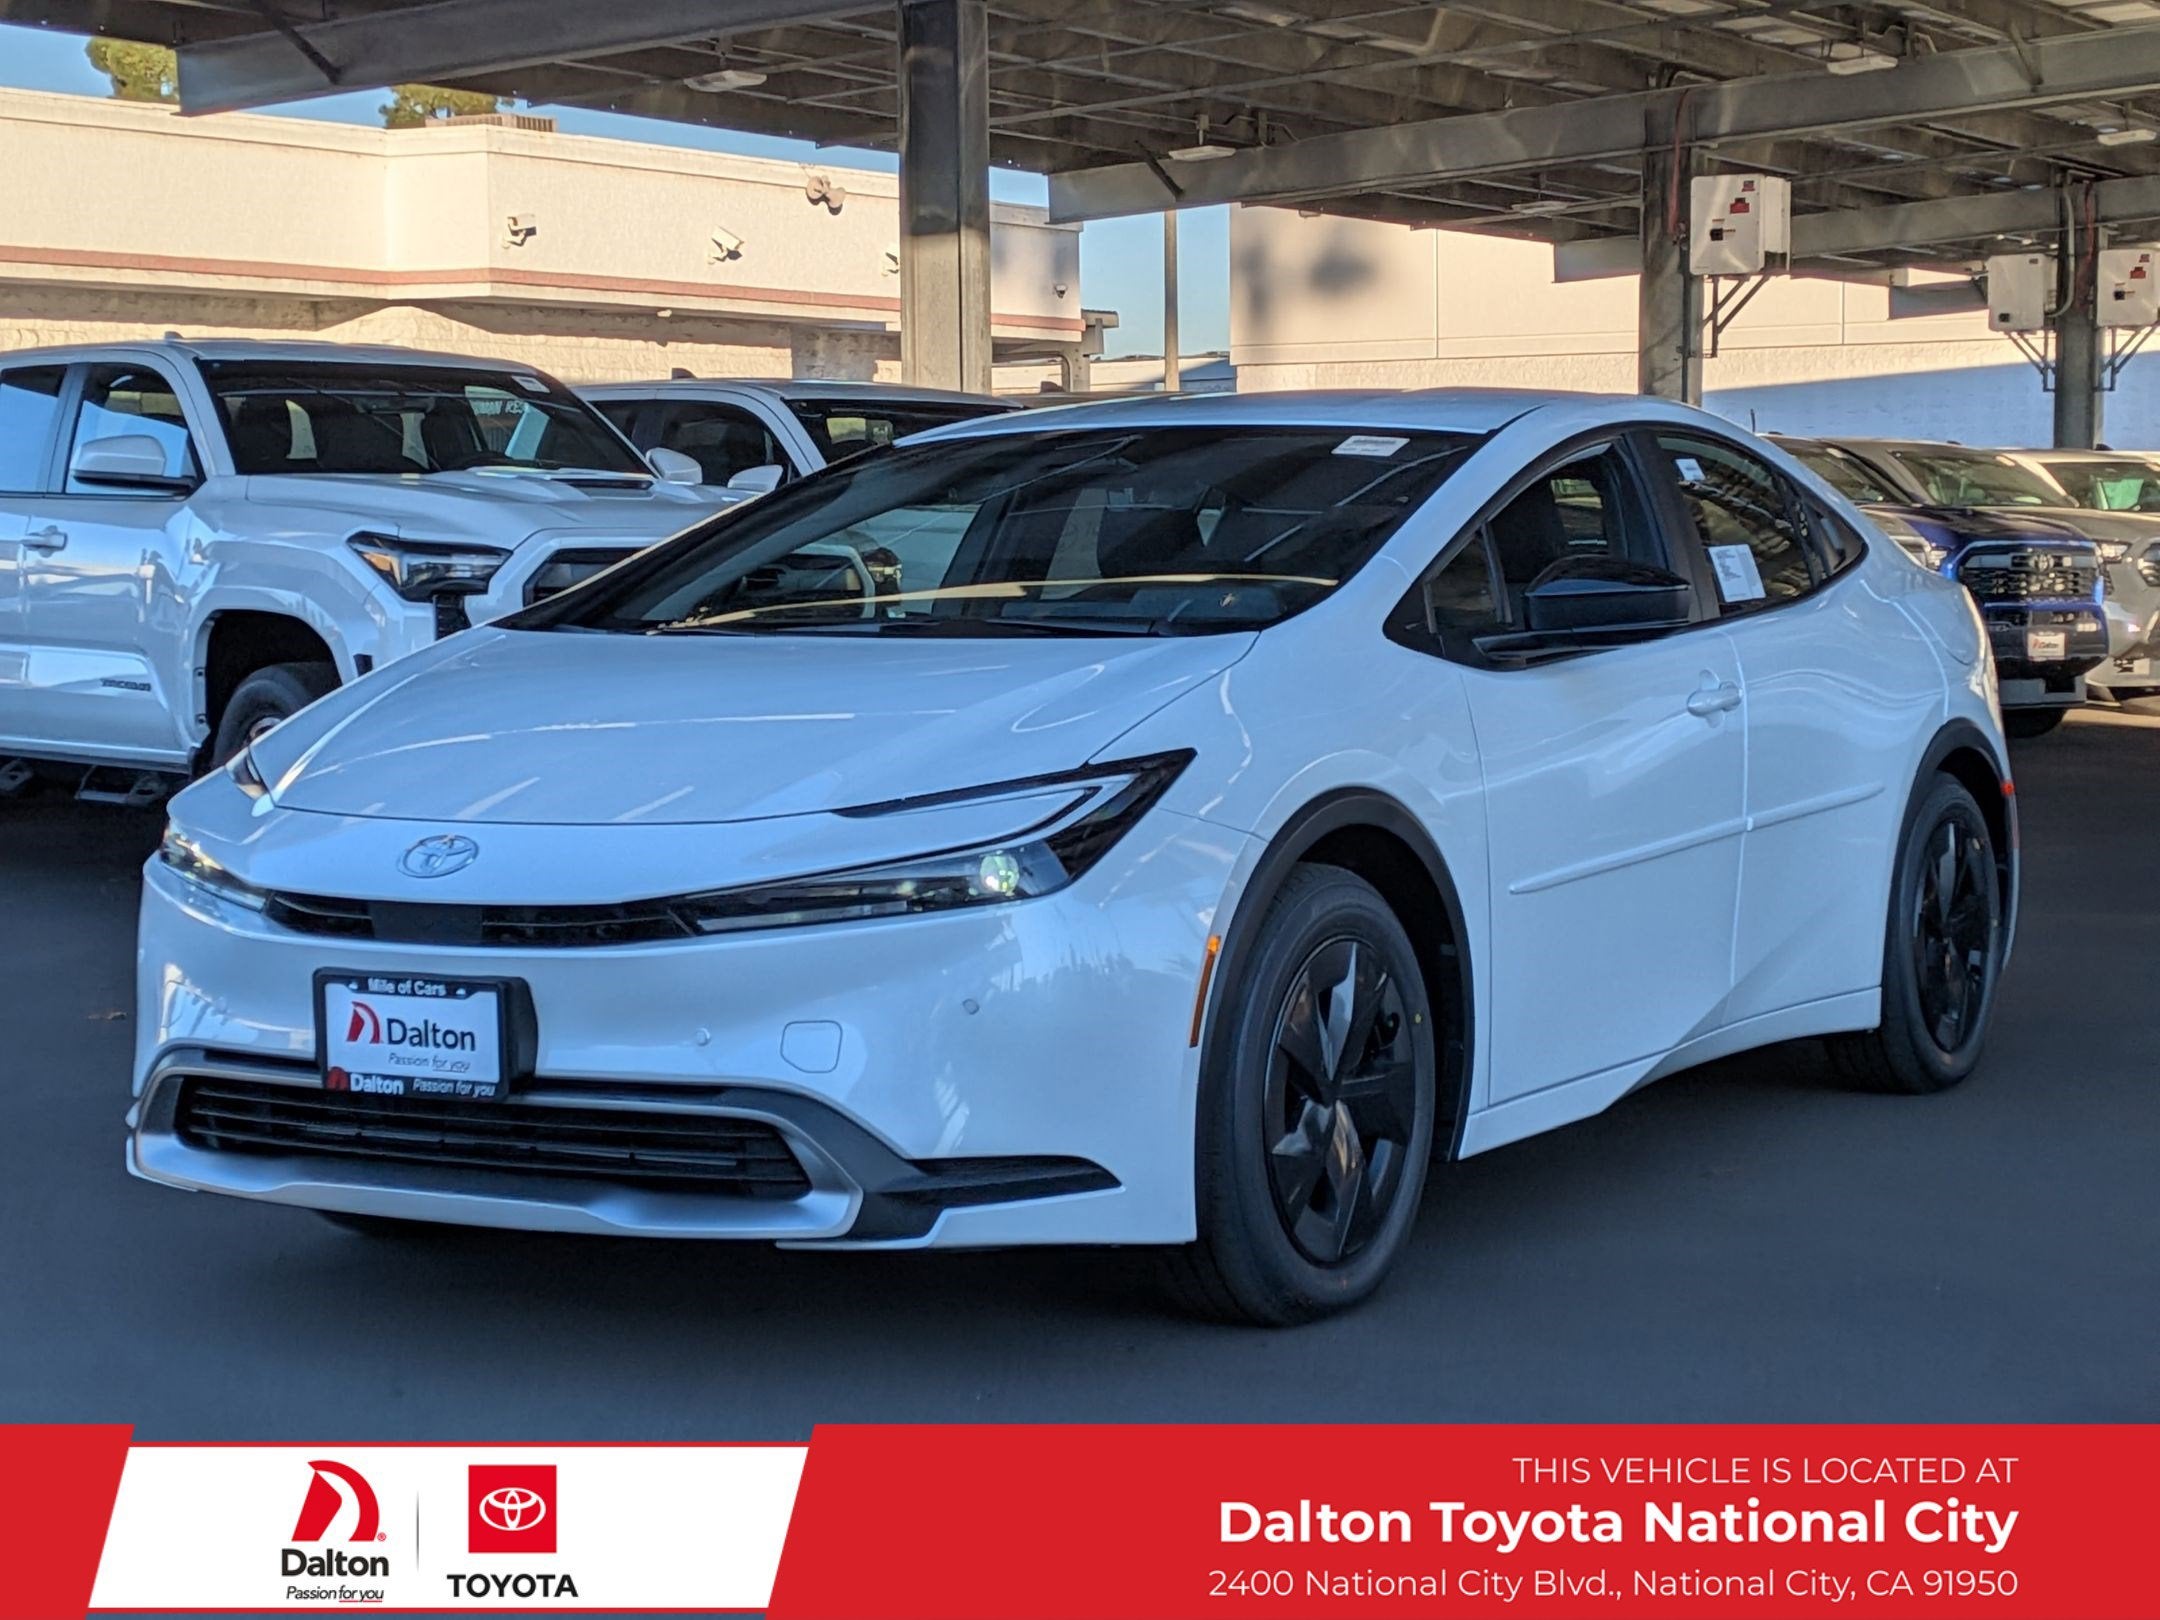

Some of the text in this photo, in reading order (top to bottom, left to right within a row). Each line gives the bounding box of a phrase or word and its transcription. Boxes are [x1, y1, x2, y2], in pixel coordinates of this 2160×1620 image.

[367, 978, 447, 996] Mile of Cars
[386, 1018, 476, 1051] Dalton
[388, 1052, 471, 1073] Passion for you
[350, 1073, 405, 1095] Dalton
[412, 1078, 496, 1098] Passion for you
